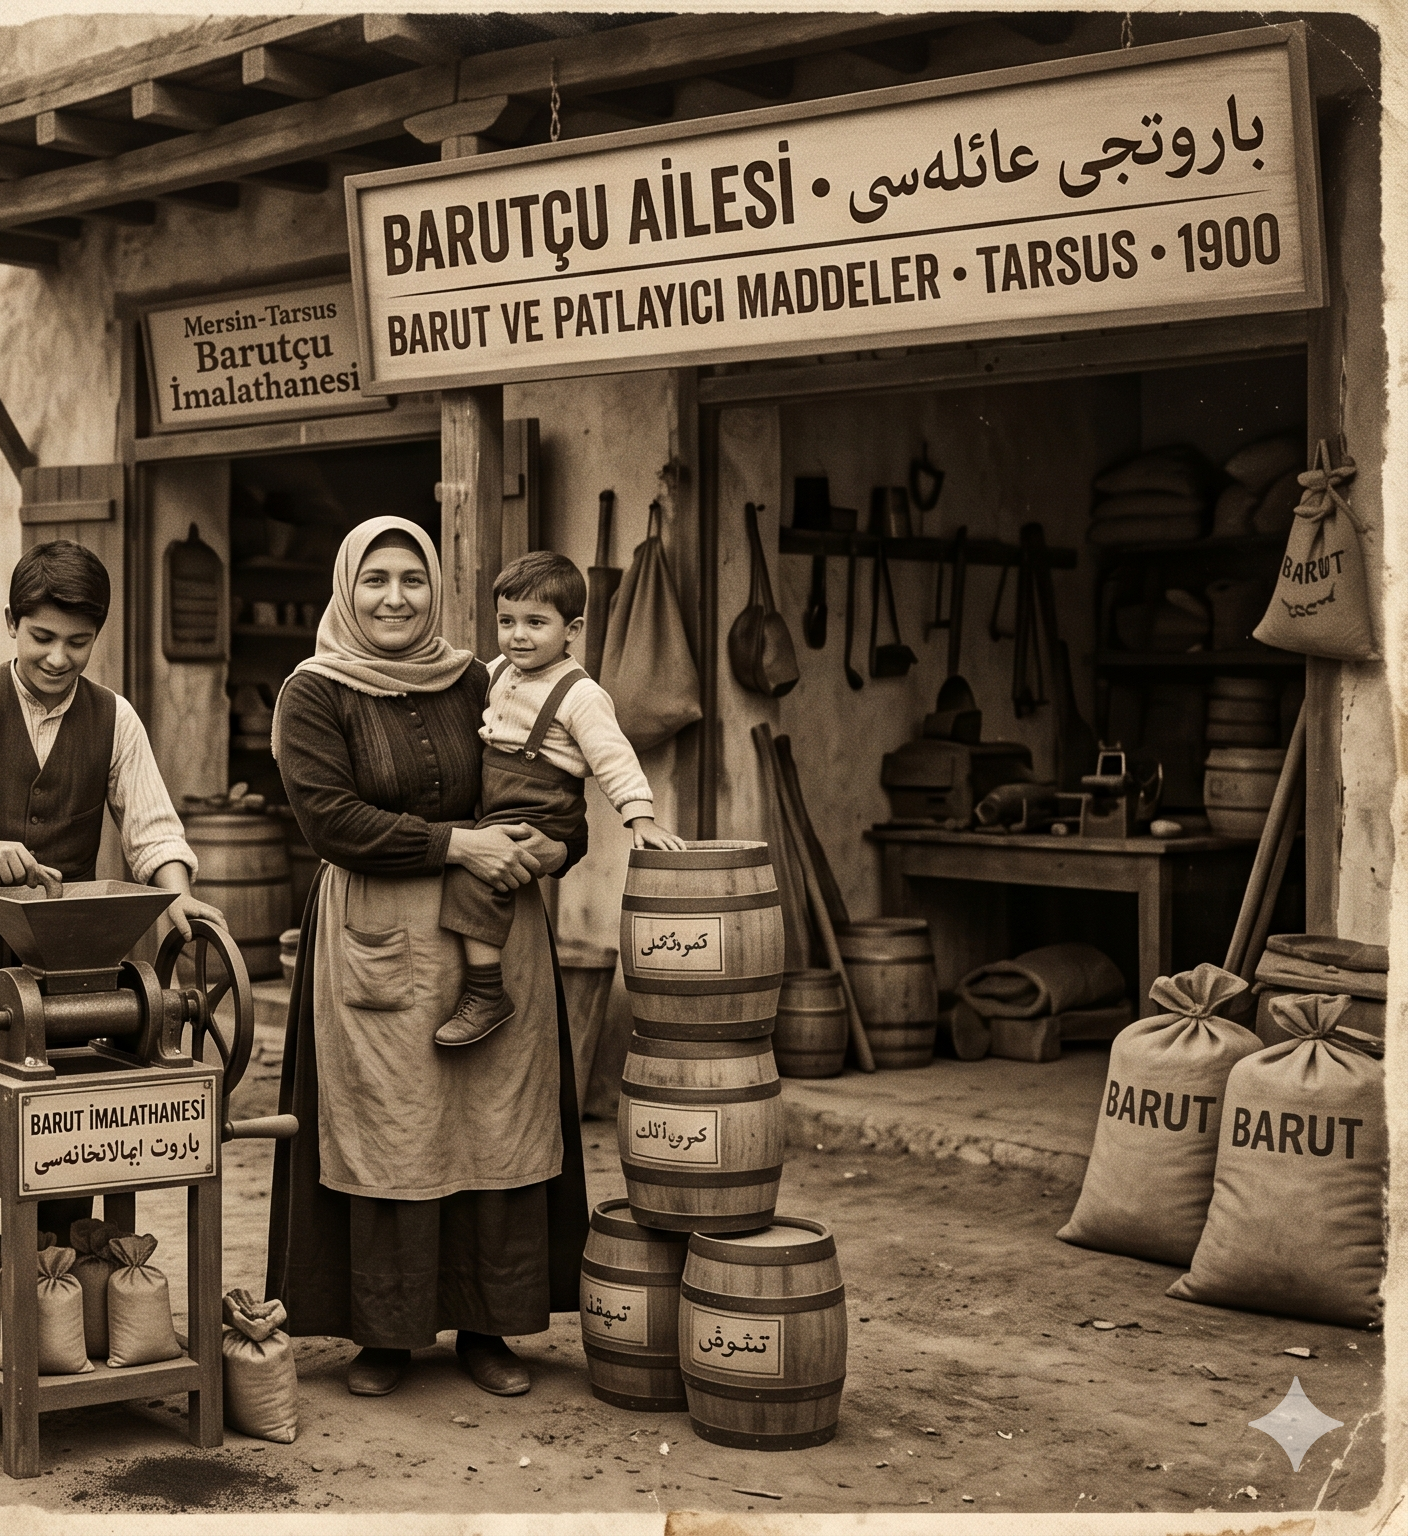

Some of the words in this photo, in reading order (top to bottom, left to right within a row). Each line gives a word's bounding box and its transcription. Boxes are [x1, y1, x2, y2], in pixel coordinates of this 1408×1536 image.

[383, 184, 609, 276] BARUTÇU
[629, 140, 794, 245] AİLESİ
[387, 305, 490, 357] BARUT
[501, 299, 544, 344] VE
[553, 278, 725, 339] PATLAYICI
[737, 253, 941, 320] MADDELER
[976, 230, 1138, 294] TARSUS
[1177, 213, 1281, 273] 1900
[183, 302, 338, 338] Mersin-Tarsus
[193, 333, 334, 373] Barutçu
[169, 362, 361, 411] İmalathanesi
[1282, 550, 1344, 585] BARUT
[31, 1110, 84, 1136] BARUT
[89, 1094, 206, 1130] İMALATHANESİ
[1105, 1079, 1217, 1134] BARUT
[150, 1132, 199, 1160] باروت
[1231, 1106, 1363, 1160] BARUT
